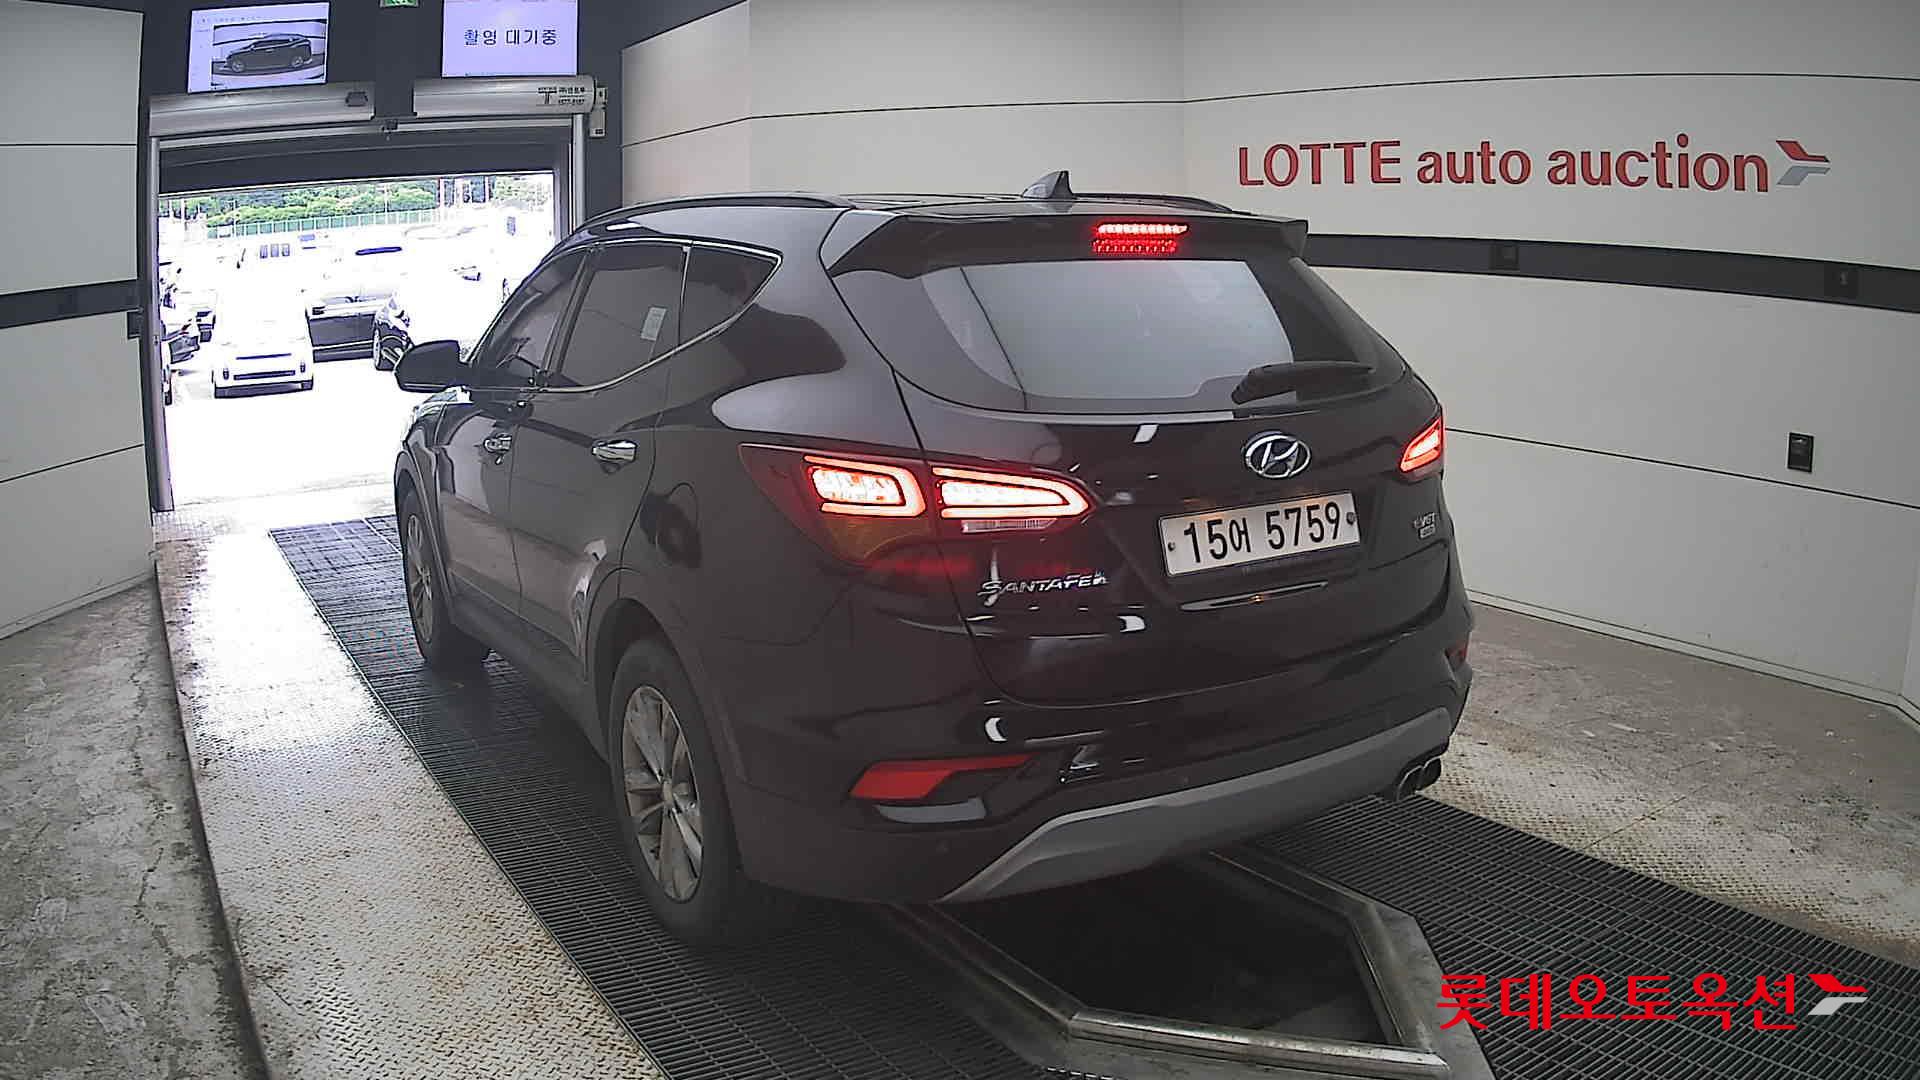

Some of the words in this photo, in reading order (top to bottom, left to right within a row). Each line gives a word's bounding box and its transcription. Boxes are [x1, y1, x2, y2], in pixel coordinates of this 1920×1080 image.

[464, 29, 497, 46] 촬영
[505, 29, 557, 46] 대기중
[1238, 140, 1400, 187] LOTTE
[1416, 140, 1532, 185] auto
[1546, 133, 1769, 193] auction
[1183, 517, 1252, 564] 15어
[1265, 501, 1341, 551] 5759
